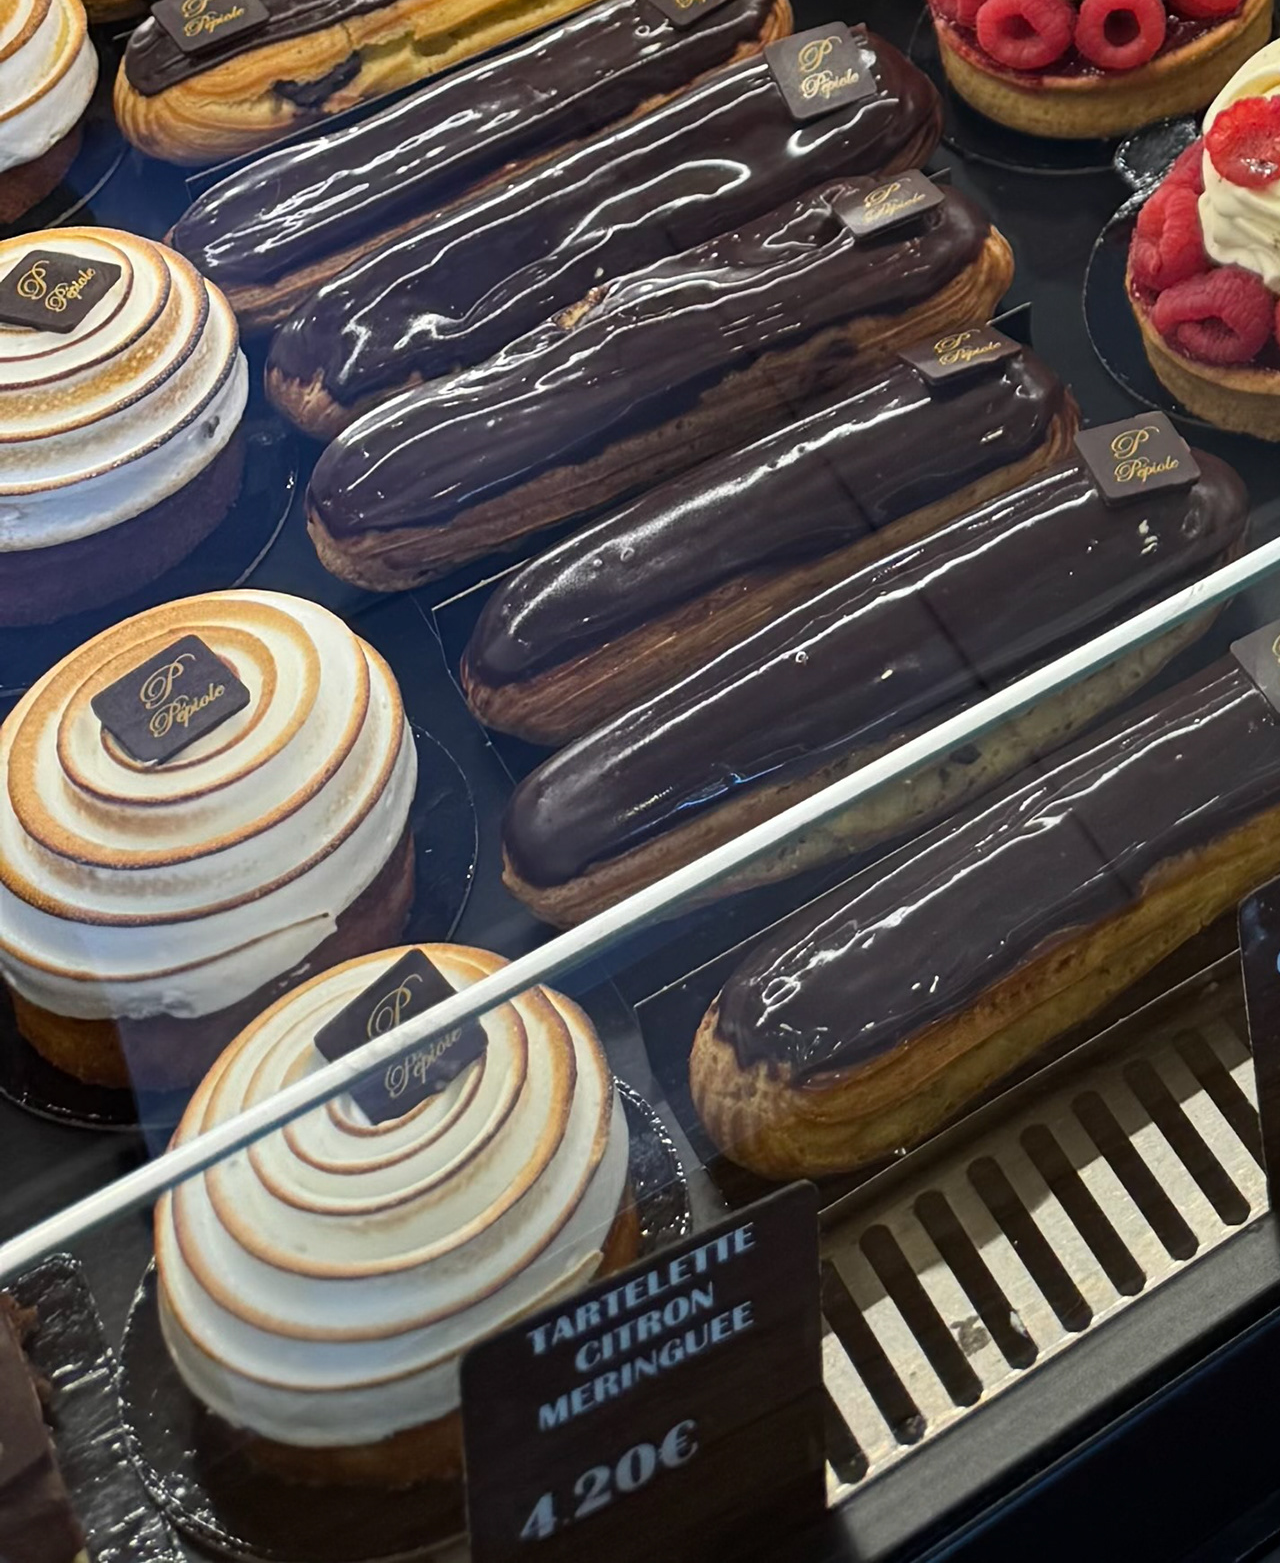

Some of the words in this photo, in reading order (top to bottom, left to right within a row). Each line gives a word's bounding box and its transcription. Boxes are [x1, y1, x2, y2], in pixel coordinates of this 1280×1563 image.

[798, 36, 842, 73] P
[1110, 425, 1161, 460] P
[1114, 455, 1180, 484] Pépiole
[140, 653, 197, 710] P
[149, 682, 226, 738] Pépiole
[366, 973, 423, 1041] P
[526, 1222, 756, 1355] TARTELETTE
[574, 1281, 714, 1373] CITRON
[538, 1301, 755, 1431] MERINGUEE
